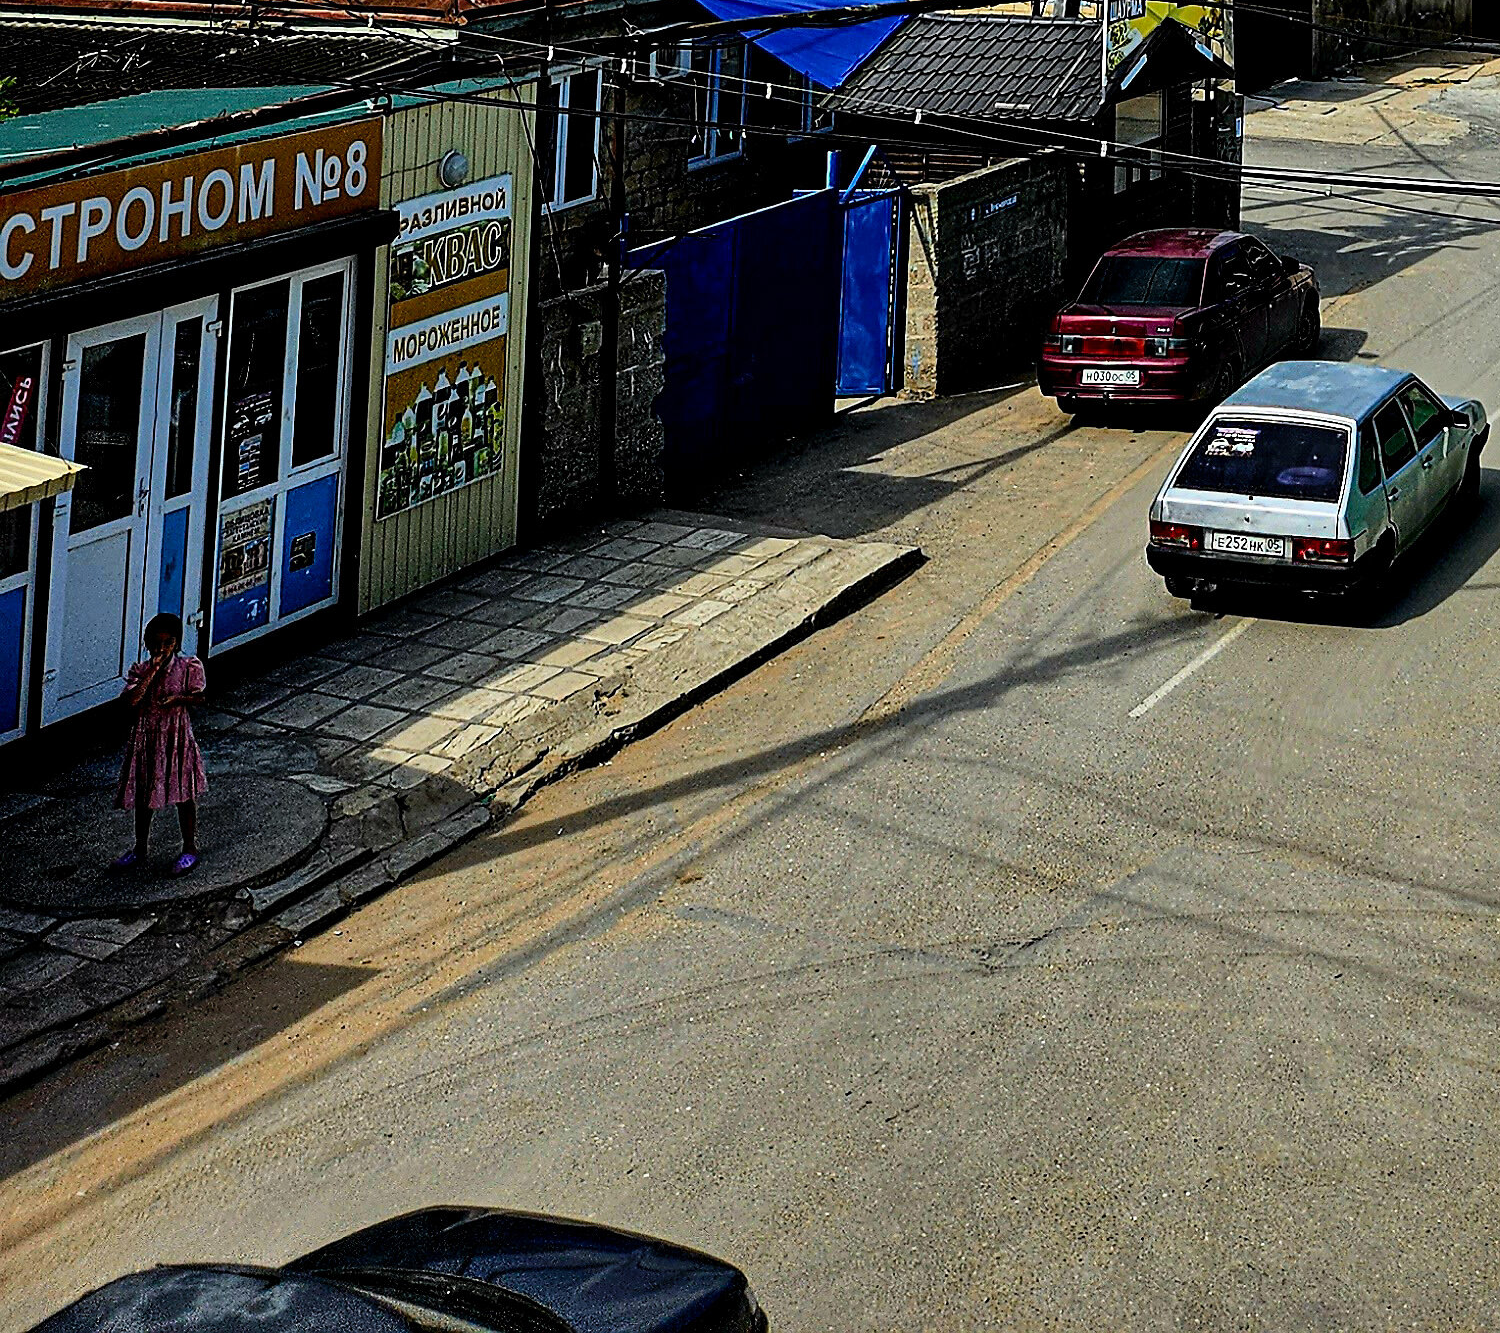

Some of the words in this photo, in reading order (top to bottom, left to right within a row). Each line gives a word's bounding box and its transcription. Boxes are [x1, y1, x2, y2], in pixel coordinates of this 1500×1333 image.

[1109, 0, 1143, 22] ШАУРМА
[0, 158, 275, 281] СТРОНОМ
[294, 140, 367, 211] №8
[399, 187, 506, 234] РАЗЛИВНОЙ
[423, 220, 502, 288] КВАС
[393, 305, 501, 364] МОРОЖЕННОЕ
